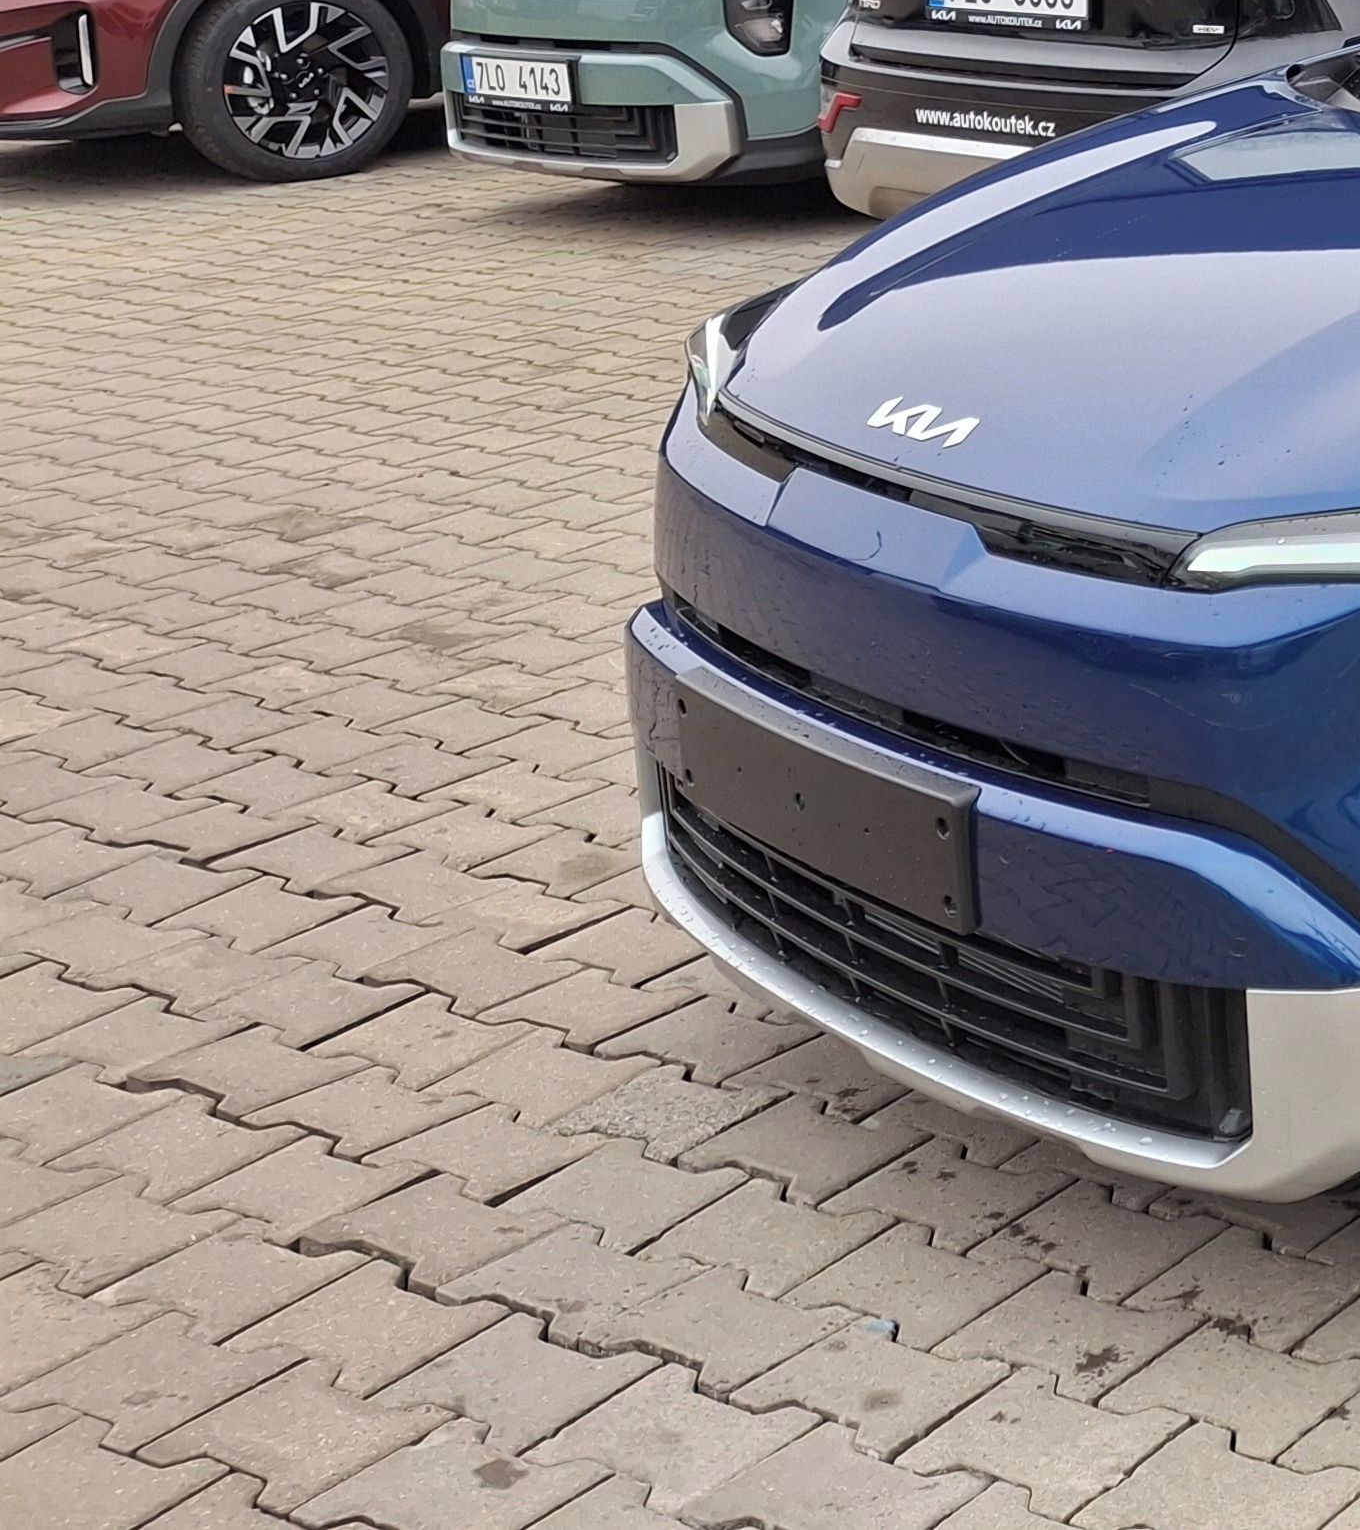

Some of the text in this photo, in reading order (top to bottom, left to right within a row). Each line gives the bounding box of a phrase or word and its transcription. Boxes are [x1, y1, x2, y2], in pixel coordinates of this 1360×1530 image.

[931, 10, 956, 21] KIA
[1055, 19, 1081, 30] KIA
[518, 65, 561, 96] 4143
[915, 107, 1056, 137] www.autokoutek.cz
[867, 396, 981, 448] KIA
